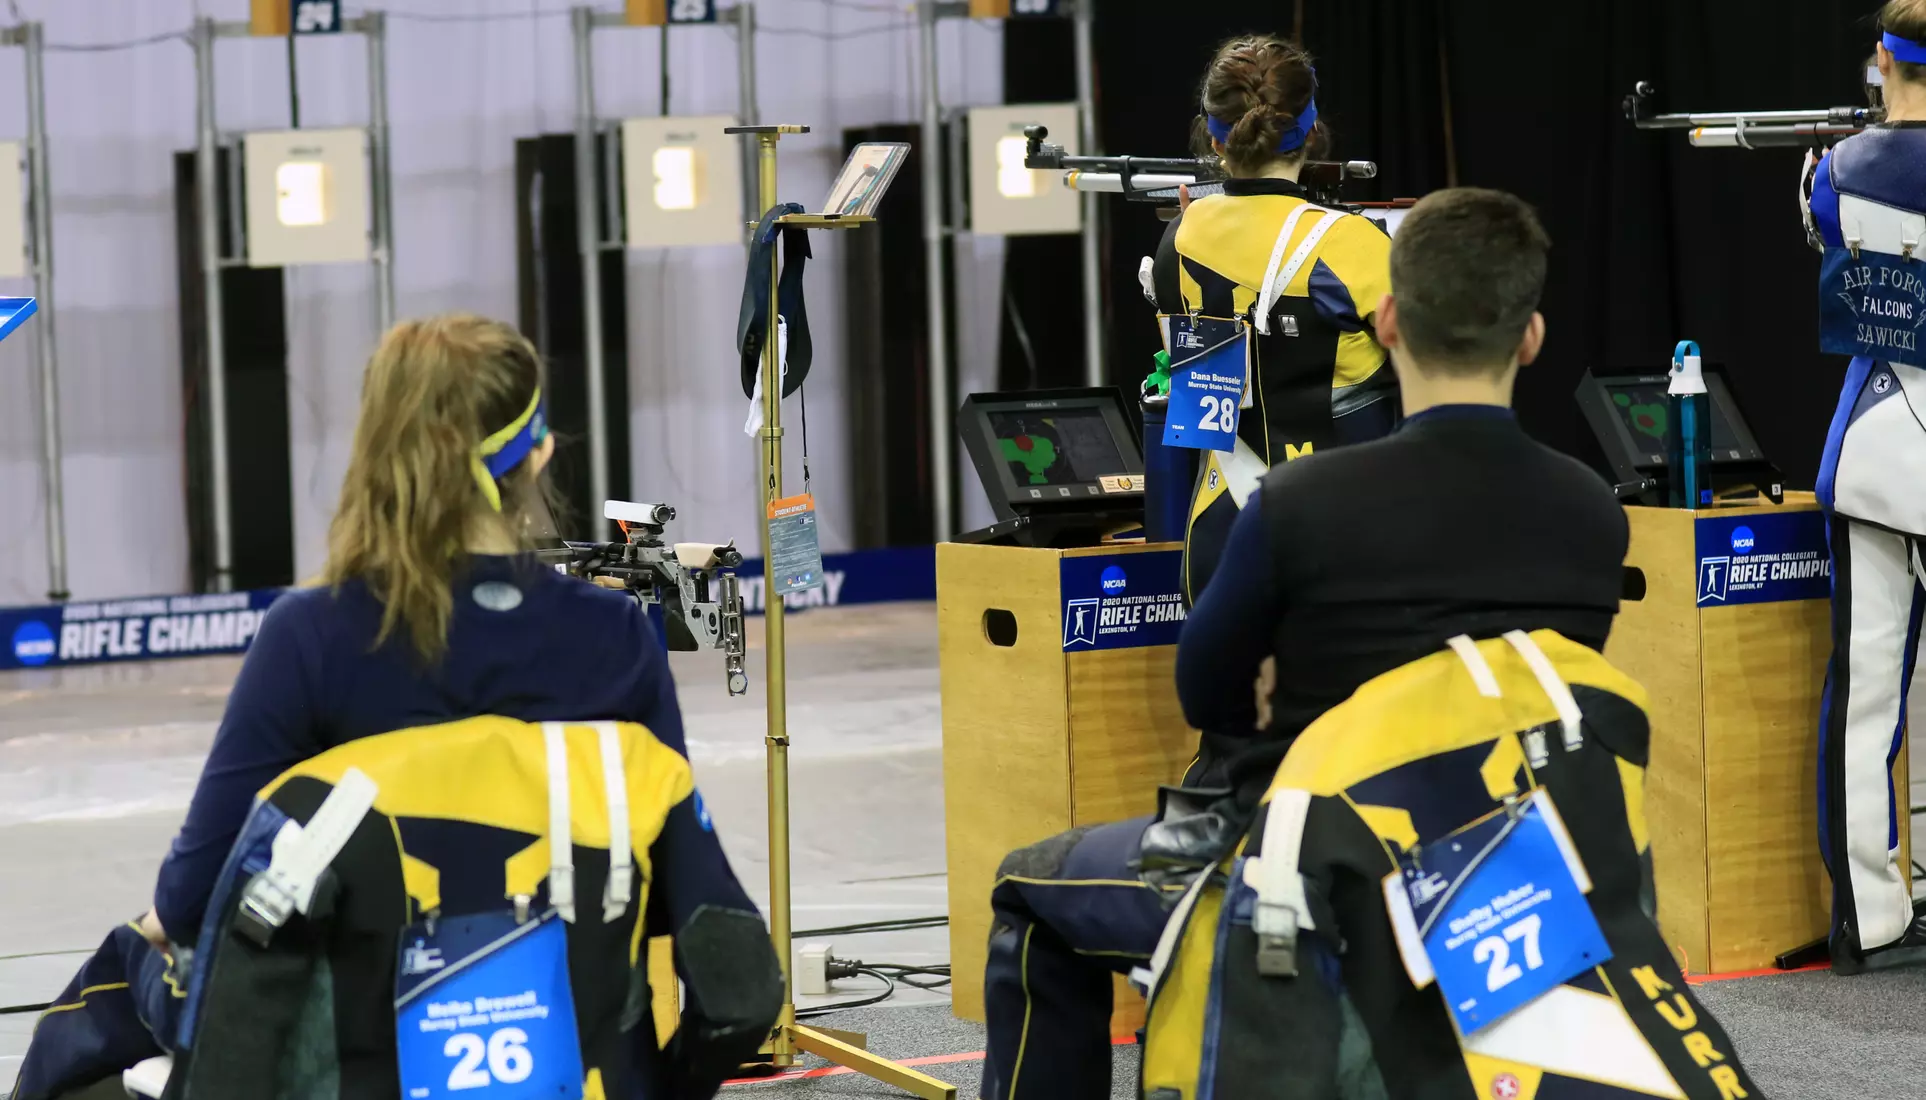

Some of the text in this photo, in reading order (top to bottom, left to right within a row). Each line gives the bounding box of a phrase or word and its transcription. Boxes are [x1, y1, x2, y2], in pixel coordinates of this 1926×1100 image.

[1842, 266, 1926, 303] AIR FORCE
[1862, 296, 1913, 319] FALCONS
[1857, 323, 1916, 351] SAWICKI
[1188, 381, 1208, 390] Murray
[1209, 383, 1222, 391] State
[1191, 371, 1211, 381] Dana
[1198, 395, 1234, 433] 28
[1733, 539, 1754, 548] NCAA
[1732, 551, 1817, 564] 2020 NATIONAL COLLEGIATE
[1730, 563, 1768, 583] RIFLE
[1103, 579, 1126, 589] NCAA
[1102, 598, 1120, 606] 2020
[1121, 596, 1155, 605] NATIONAL
[1100, 605, 1142, 626] RIFLE
[59, 618, 144, 659] RIFLE
[1473, 913, 1544, 993] 27
[443, 1026, 534, 1091] 26
